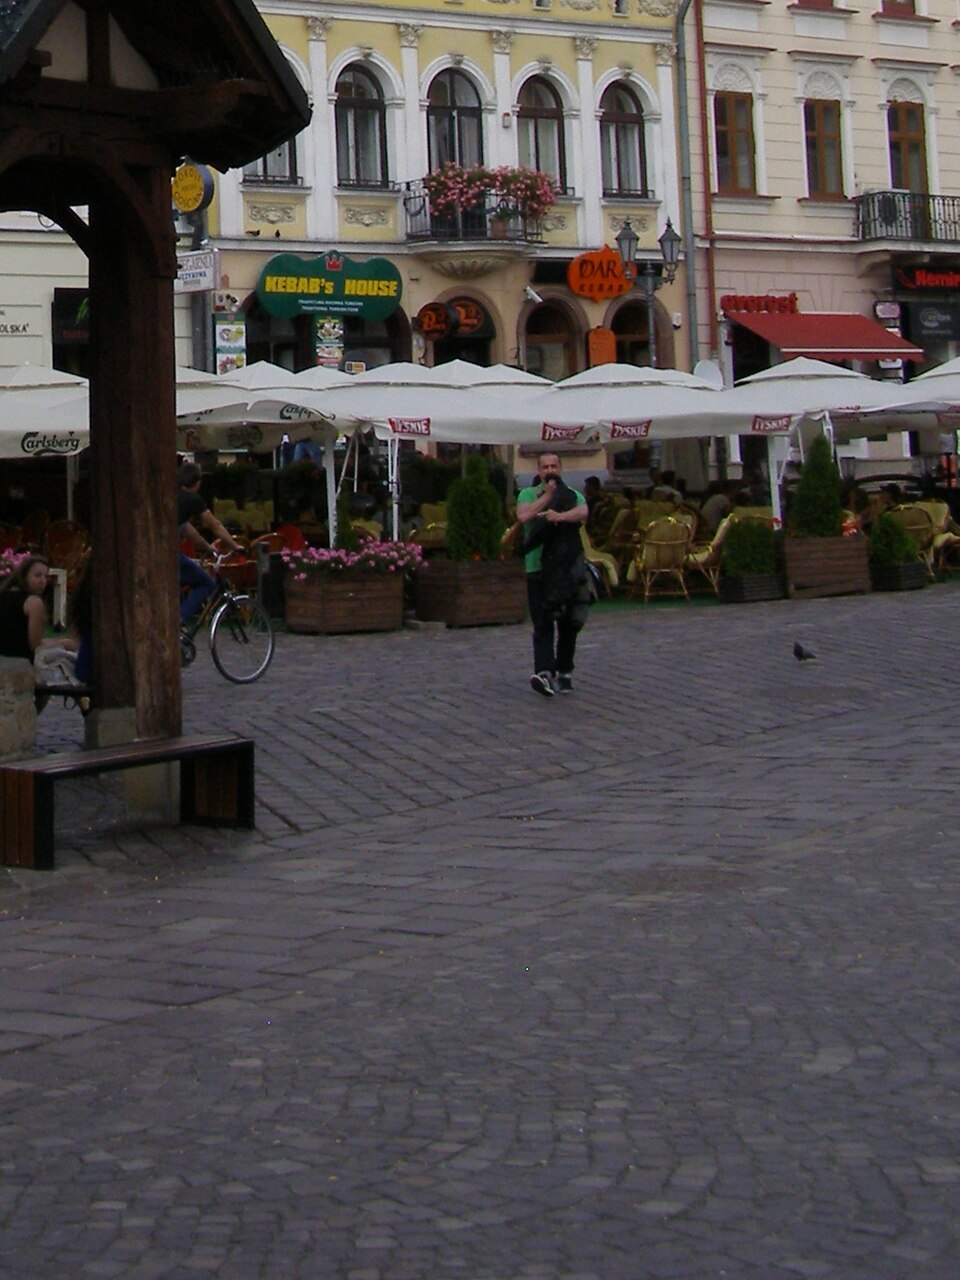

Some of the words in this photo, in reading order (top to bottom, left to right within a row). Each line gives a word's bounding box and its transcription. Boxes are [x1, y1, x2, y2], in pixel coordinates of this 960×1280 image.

[265, 276, 334, 294] KEBAB's
[344, 279, 398, 296] HOUSE
[394, 420, 428, 434] TYSKIE
[614, 424, 647, 437] TYSKIE
[21, 431, 80, 454] Carlsberg
